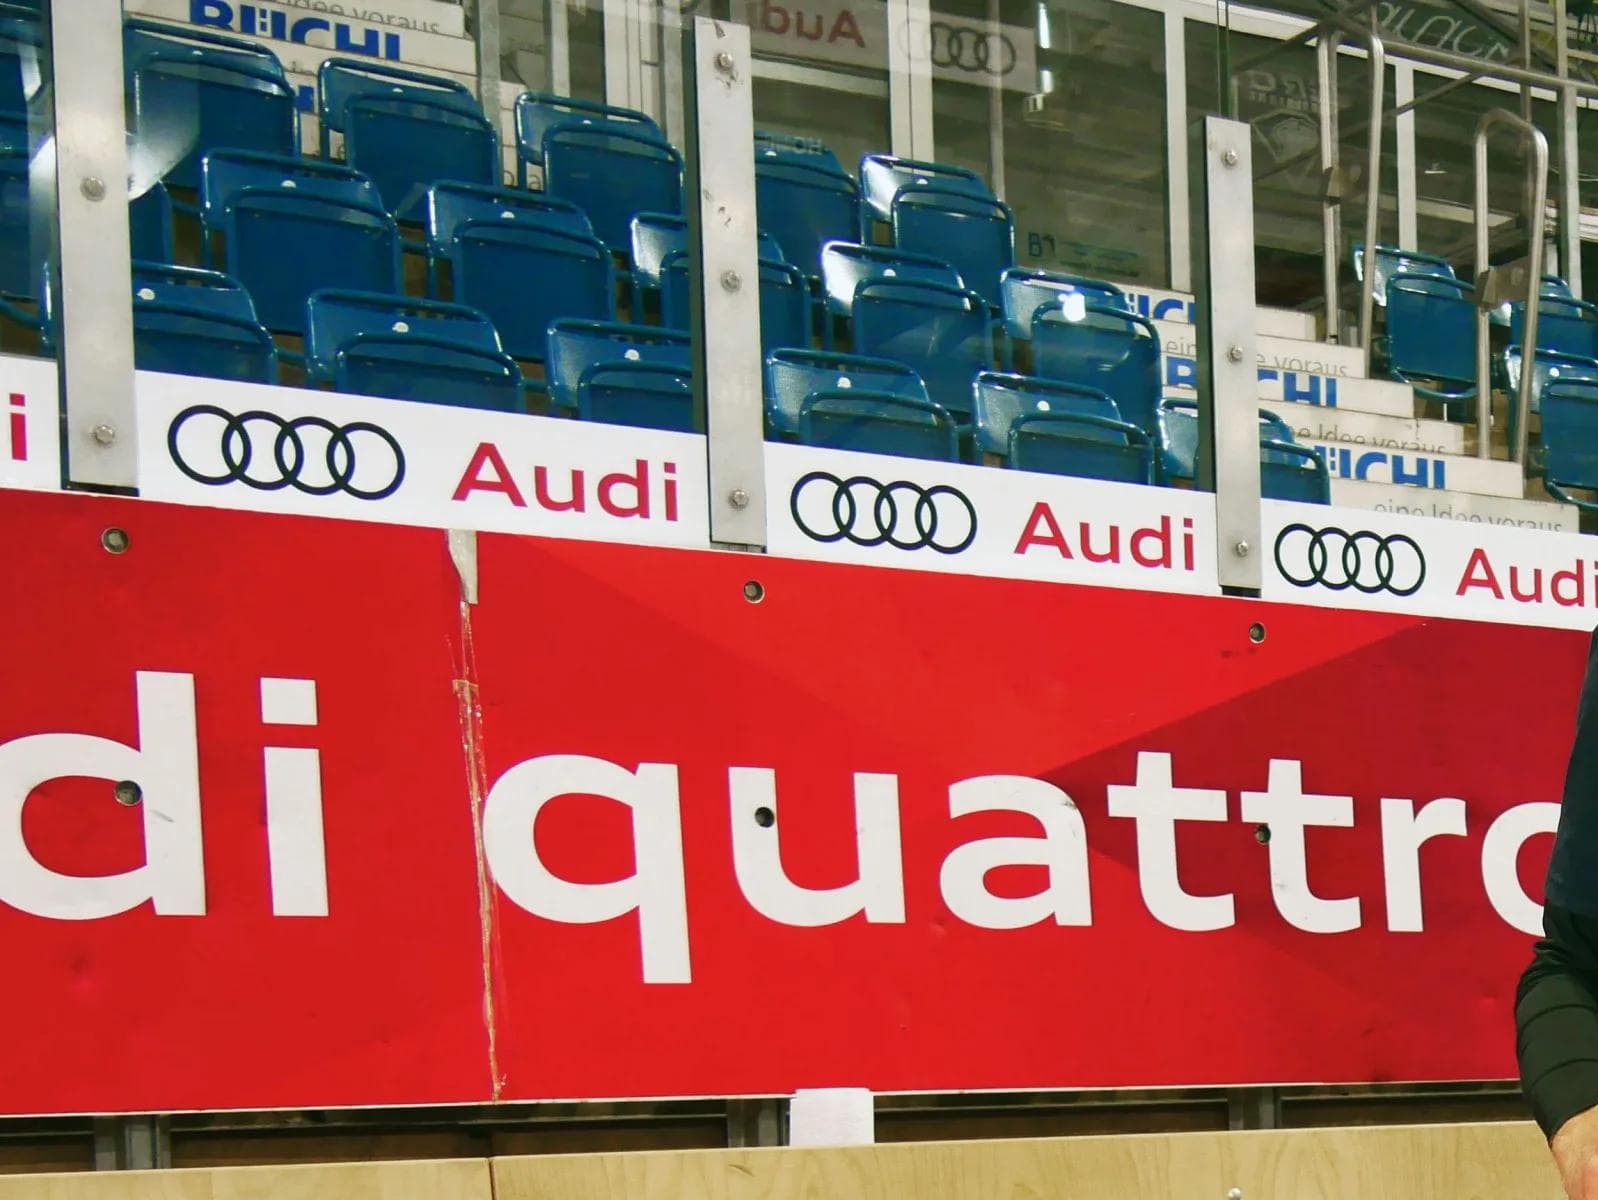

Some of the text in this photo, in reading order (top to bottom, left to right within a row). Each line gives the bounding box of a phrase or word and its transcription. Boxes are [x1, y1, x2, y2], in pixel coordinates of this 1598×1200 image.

[452, 442, 679, 521] Audi
[1013, 501, 1195, 571] Audi
[0, 670, 329, 921] di
